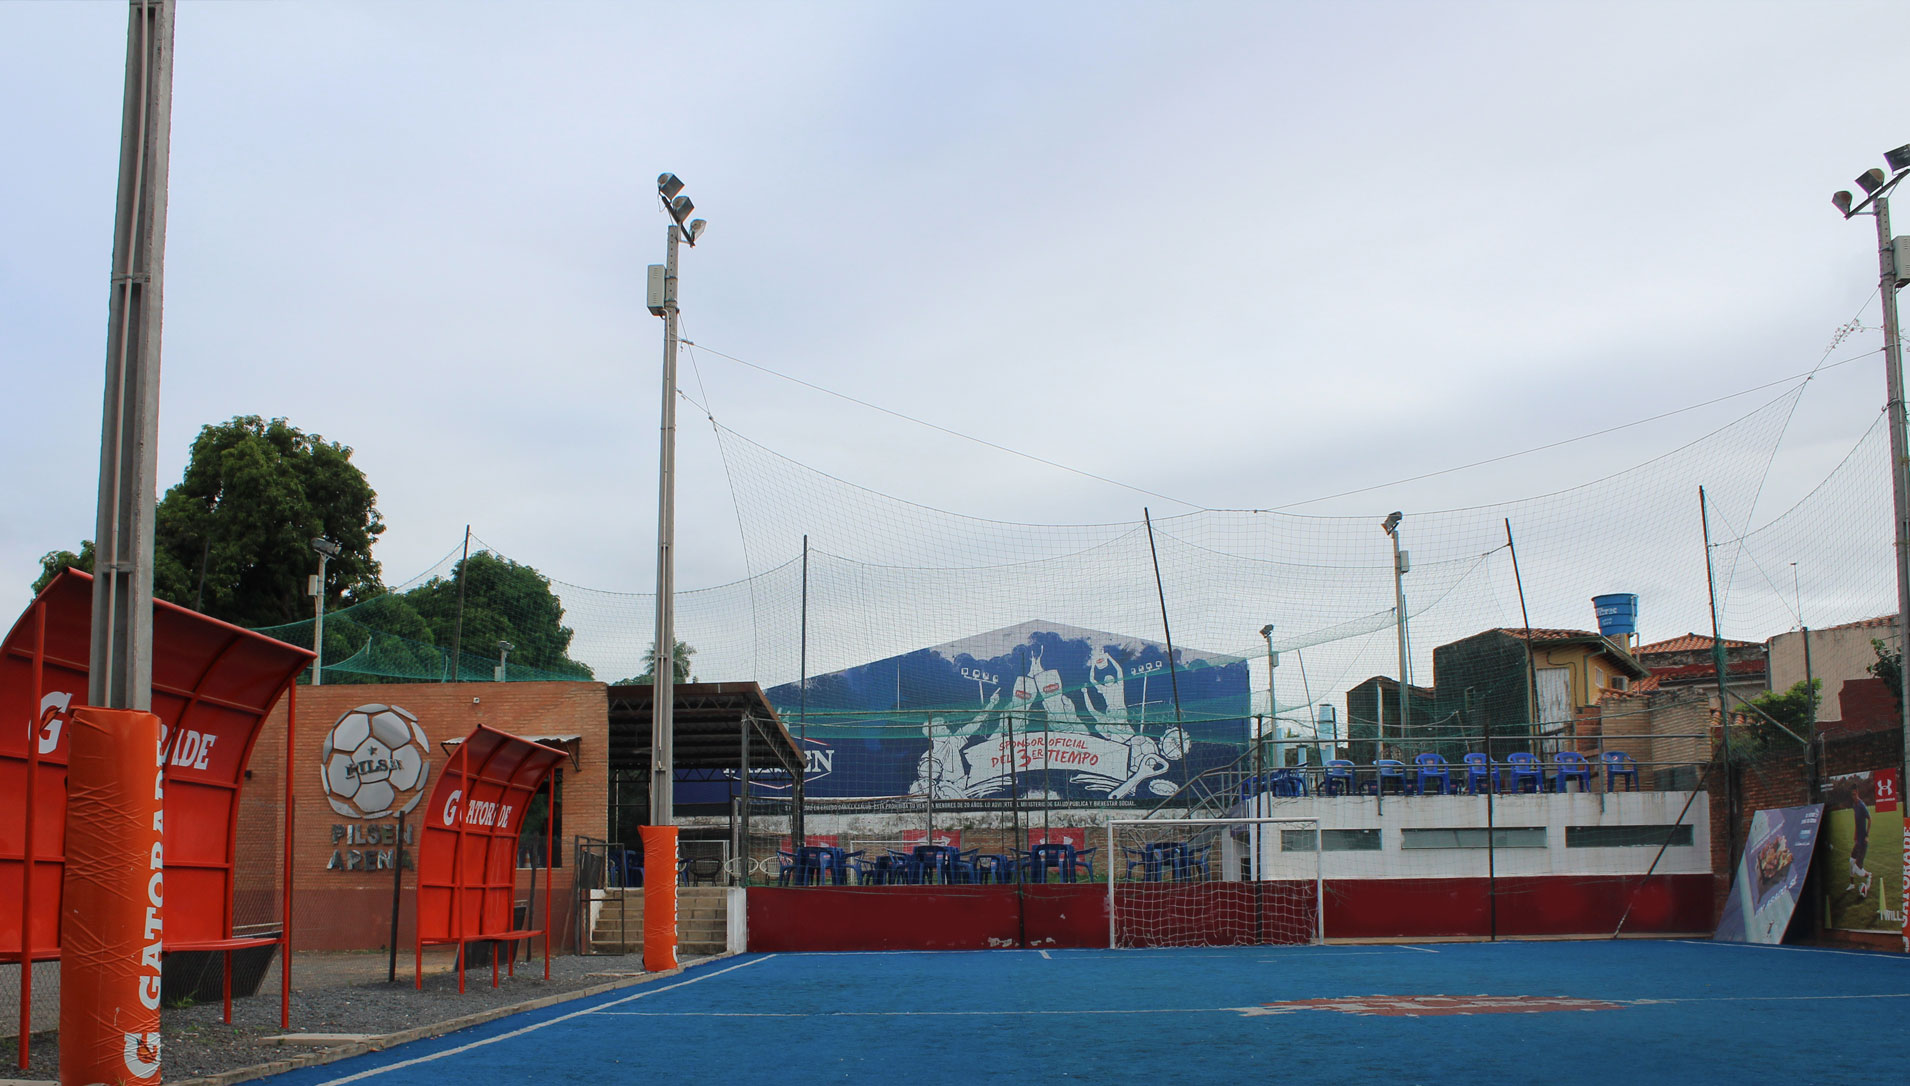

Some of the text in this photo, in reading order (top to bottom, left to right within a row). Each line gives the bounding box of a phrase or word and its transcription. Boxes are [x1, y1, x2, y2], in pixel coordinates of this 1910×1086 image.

[999, 737, 1088, 751] SPONSOR OFICIAL
[991, 754, 1012, 768] DEL
[1047, 749, 1099, 766] TIEMPO
[459, 799, 512, 828] ATORDE
[331, 824, 414, 845] PILSEN
[327, 850, 415, 871] ARENA
